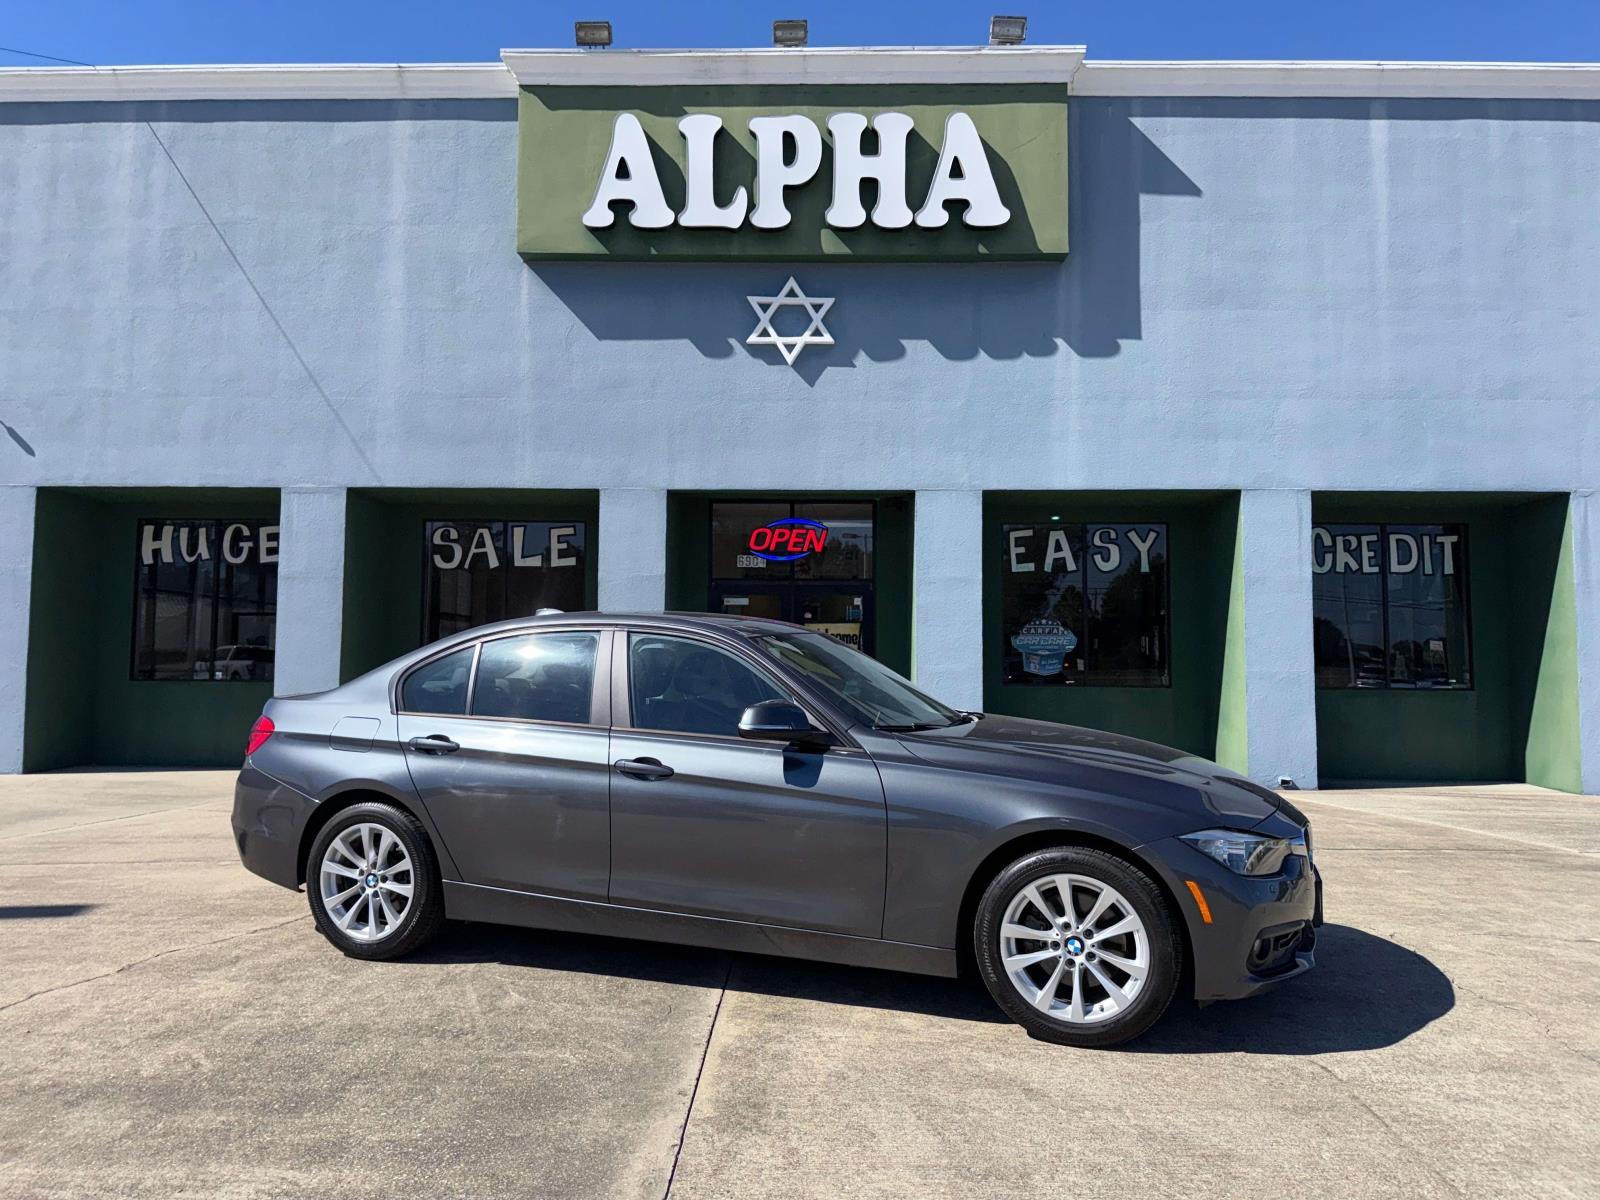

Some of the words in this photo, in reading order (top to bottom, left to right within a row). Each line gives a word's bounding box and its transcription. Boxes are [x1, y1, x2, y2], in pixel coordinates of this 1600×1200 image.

[582, 112, 1011, 230] ALPHA
[141, 523, 281, 565] HUGE
[432, 525, 577, 570] SALE
[748, 527, 828, 553] OPEN
[1008, 527, 1158, 573] EASY
[1312, 527, 1458, 575] CREDIT
